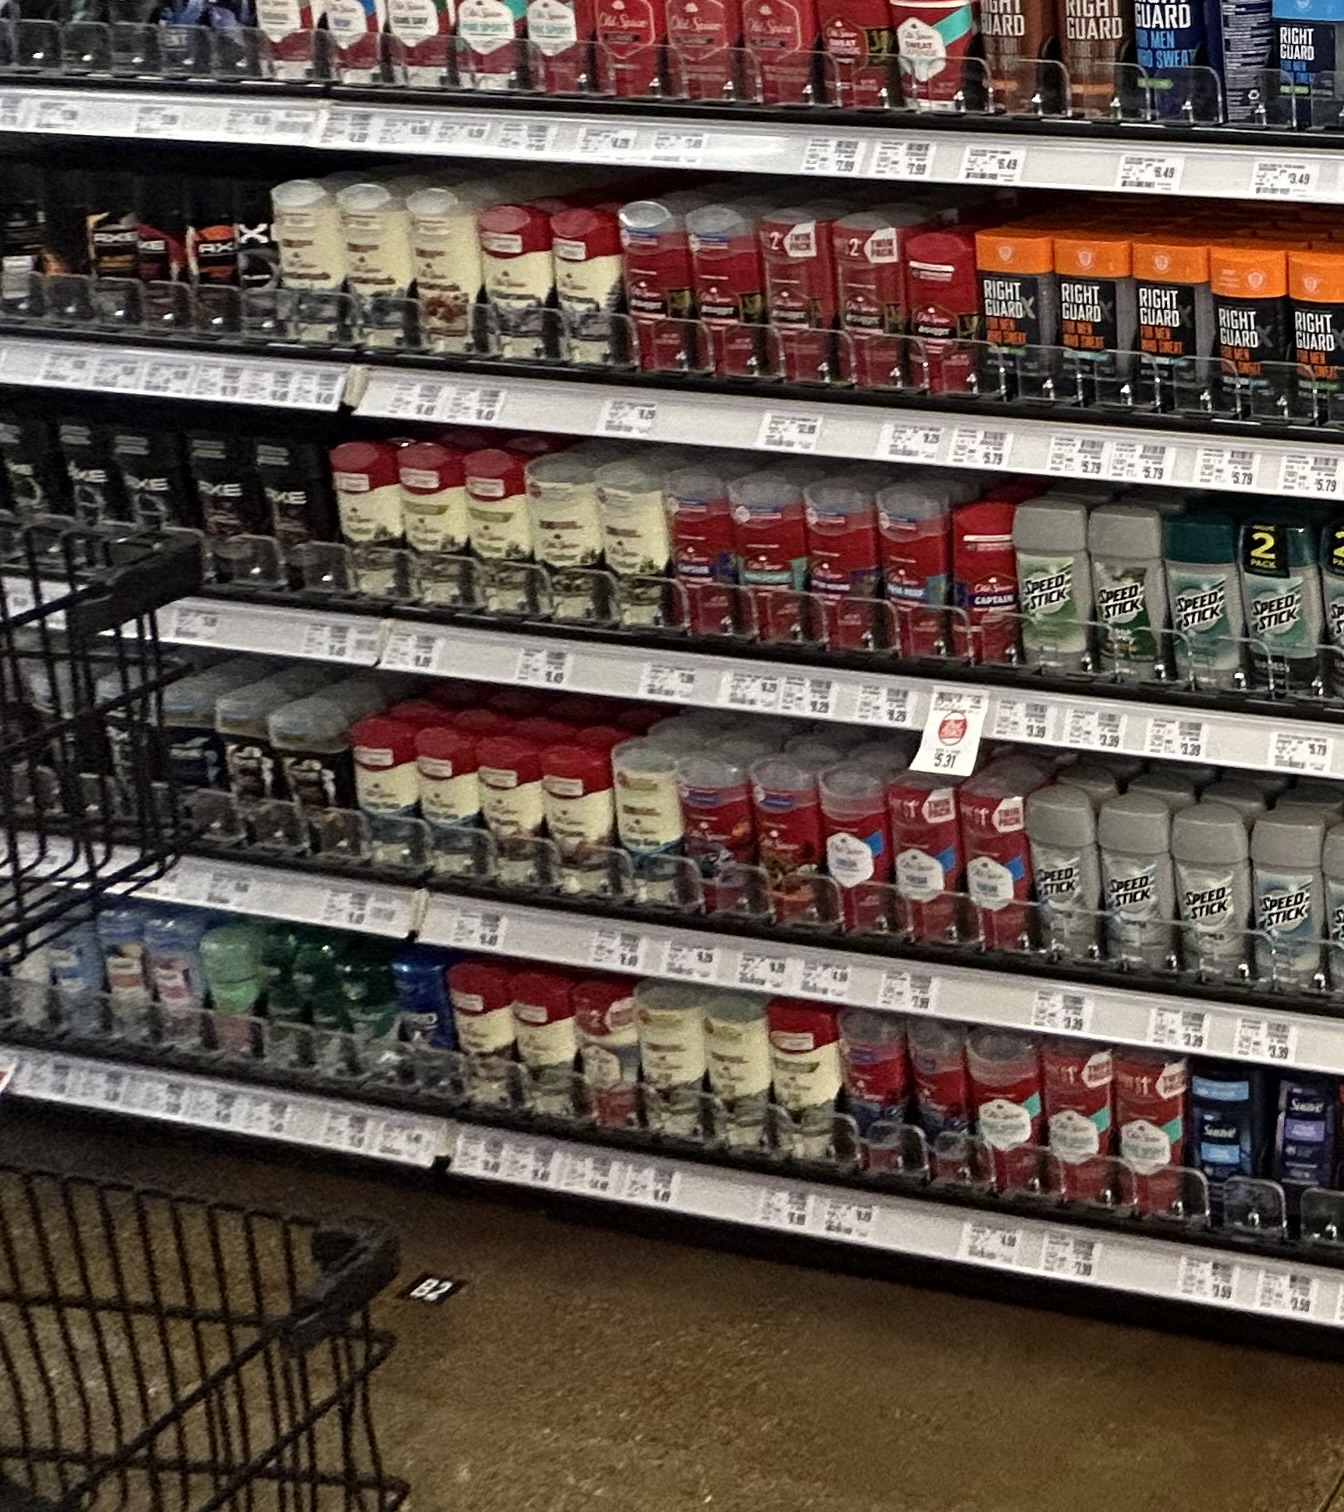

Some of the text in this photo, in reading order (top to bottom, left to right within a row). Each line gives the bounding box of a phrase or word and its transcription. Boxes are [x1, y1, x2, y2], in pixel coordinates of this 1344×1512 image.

[1135, 3, 1191, 29] GUARD
[1066, 16, 1122, 40] GUARD
[1280, 27, 1314, 45] RIGHT
[1280, 43, 1315, 61] GUARD
[984, 279, 1021, 300] RIGHT
[1061, 283, 1100, 305] RIGHT
[1139, 287, 1178, 309] RIGHT
[985, 299, 1023, 319] GUARD
[1061, 302, 1101, 323] GUARD
[1139, 306, 1180, 327] GUARD
[1219, 308, 1257, 331] RIGHT
[1295, 311, 1332, 333] RIGHT
[1219, 328, 1259, 348] GUARD
[1295, 330, 1335, 351] GUARD
[1251, 533, 1276, 558] 2
[1251, 558, 1276, 569] PACK
[1026, 574, 1065, 595] SPEED
[1100, 584, 1139, 605] SPEED
[1031, 587, 1066, 610] STICK
[1104, 597, 1141, 619] STICK
[1177, 591, 1218, 613] SPEED
[1252, 594, 1295, 617] SPEED
[1182, 605, 1221, 628] STICK
[1257, 608, 1297, 632] STICK
[1037, 868, 1073, 884] SPEED
[1110, 875, 1149, 893] SPEED
[1043, 879, 1075, 895] STICK
[1115, 888, 1151, 907] STICK
[1186, 887, 1226, 906] SPEED
[1191, 899, 1229, 919] STICK
[1262, 893, 1305, 912] SPEED
[1266, 905, 1306, 927] STICK
